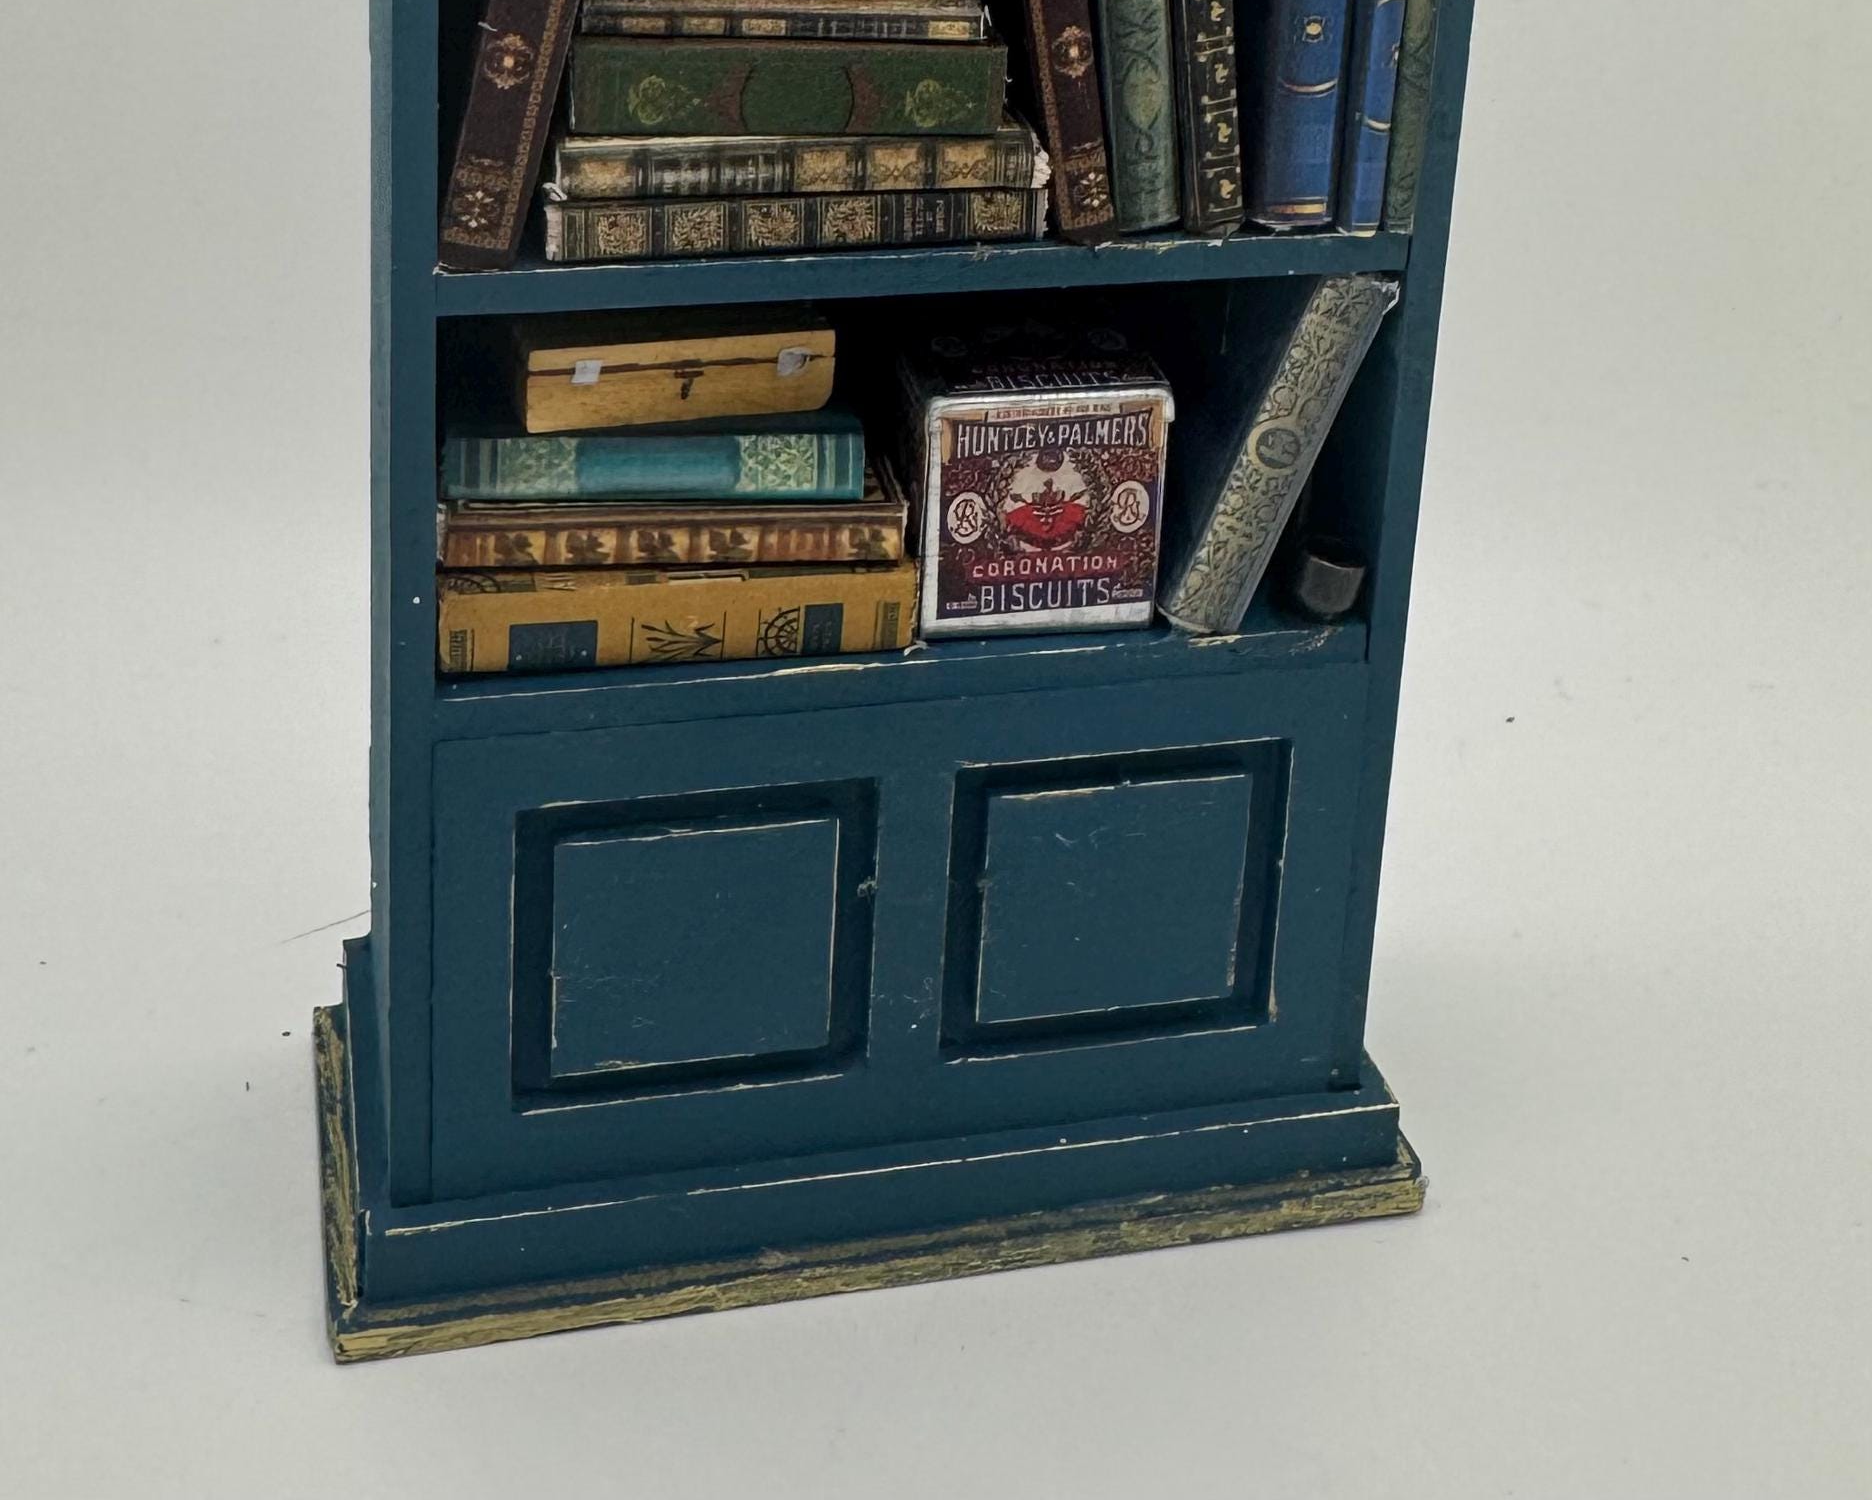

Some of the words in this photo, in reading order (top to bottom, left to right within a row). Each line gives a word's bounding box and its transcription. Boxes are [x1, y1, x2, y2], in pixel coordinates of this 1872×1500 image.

[985, 370, 1121, 391] BISCUITS
[957, 422, 1049, 459] HUNTLEY
[1058, 412, 1149, 448] PALMERS
[973, 555, 1118, 578] CORONATION
[980, 577, 1110, 613] BISCUITS
